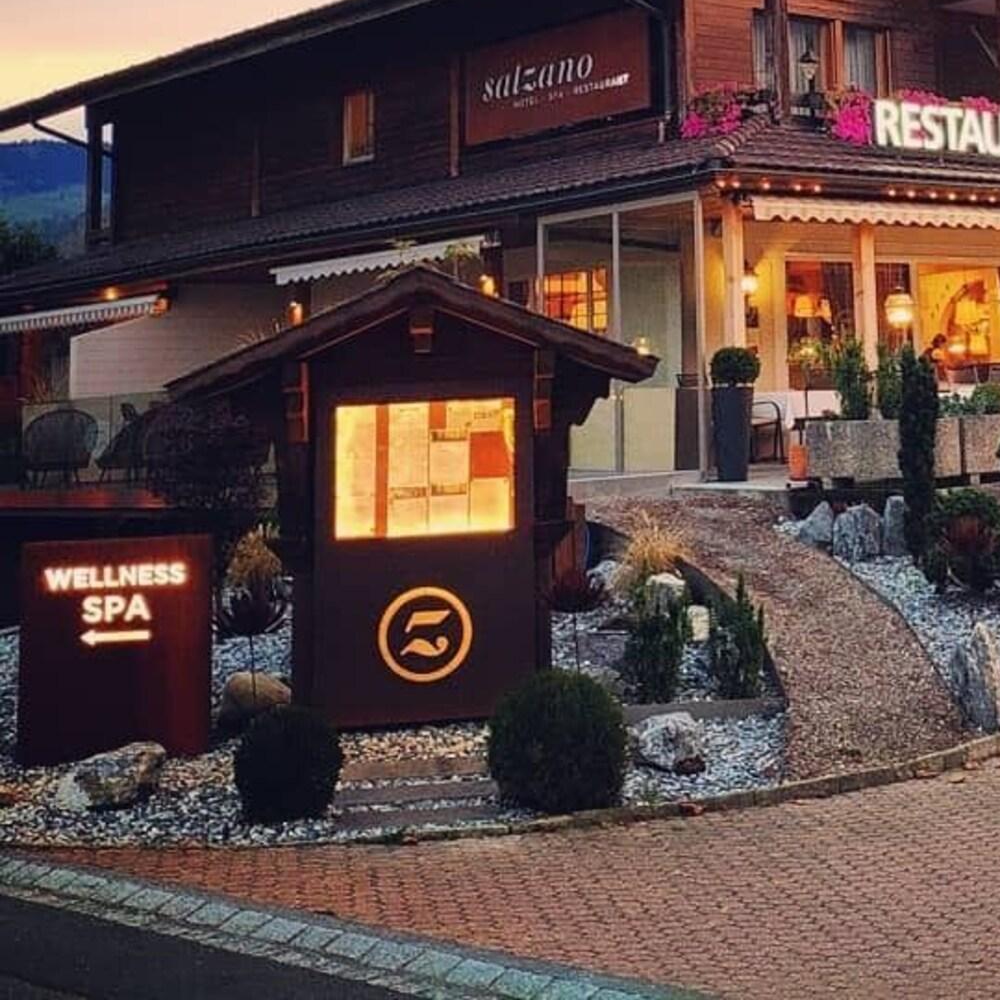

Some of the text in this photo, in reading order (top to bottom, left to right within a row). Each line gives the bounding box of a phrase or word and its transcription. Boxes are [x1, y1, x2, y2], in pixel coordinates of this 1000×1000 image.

[482, 53, 593, 102] salzano
[44, 562, 188, 591] WELLNESS
[81, 594, 151, 623] SPA
